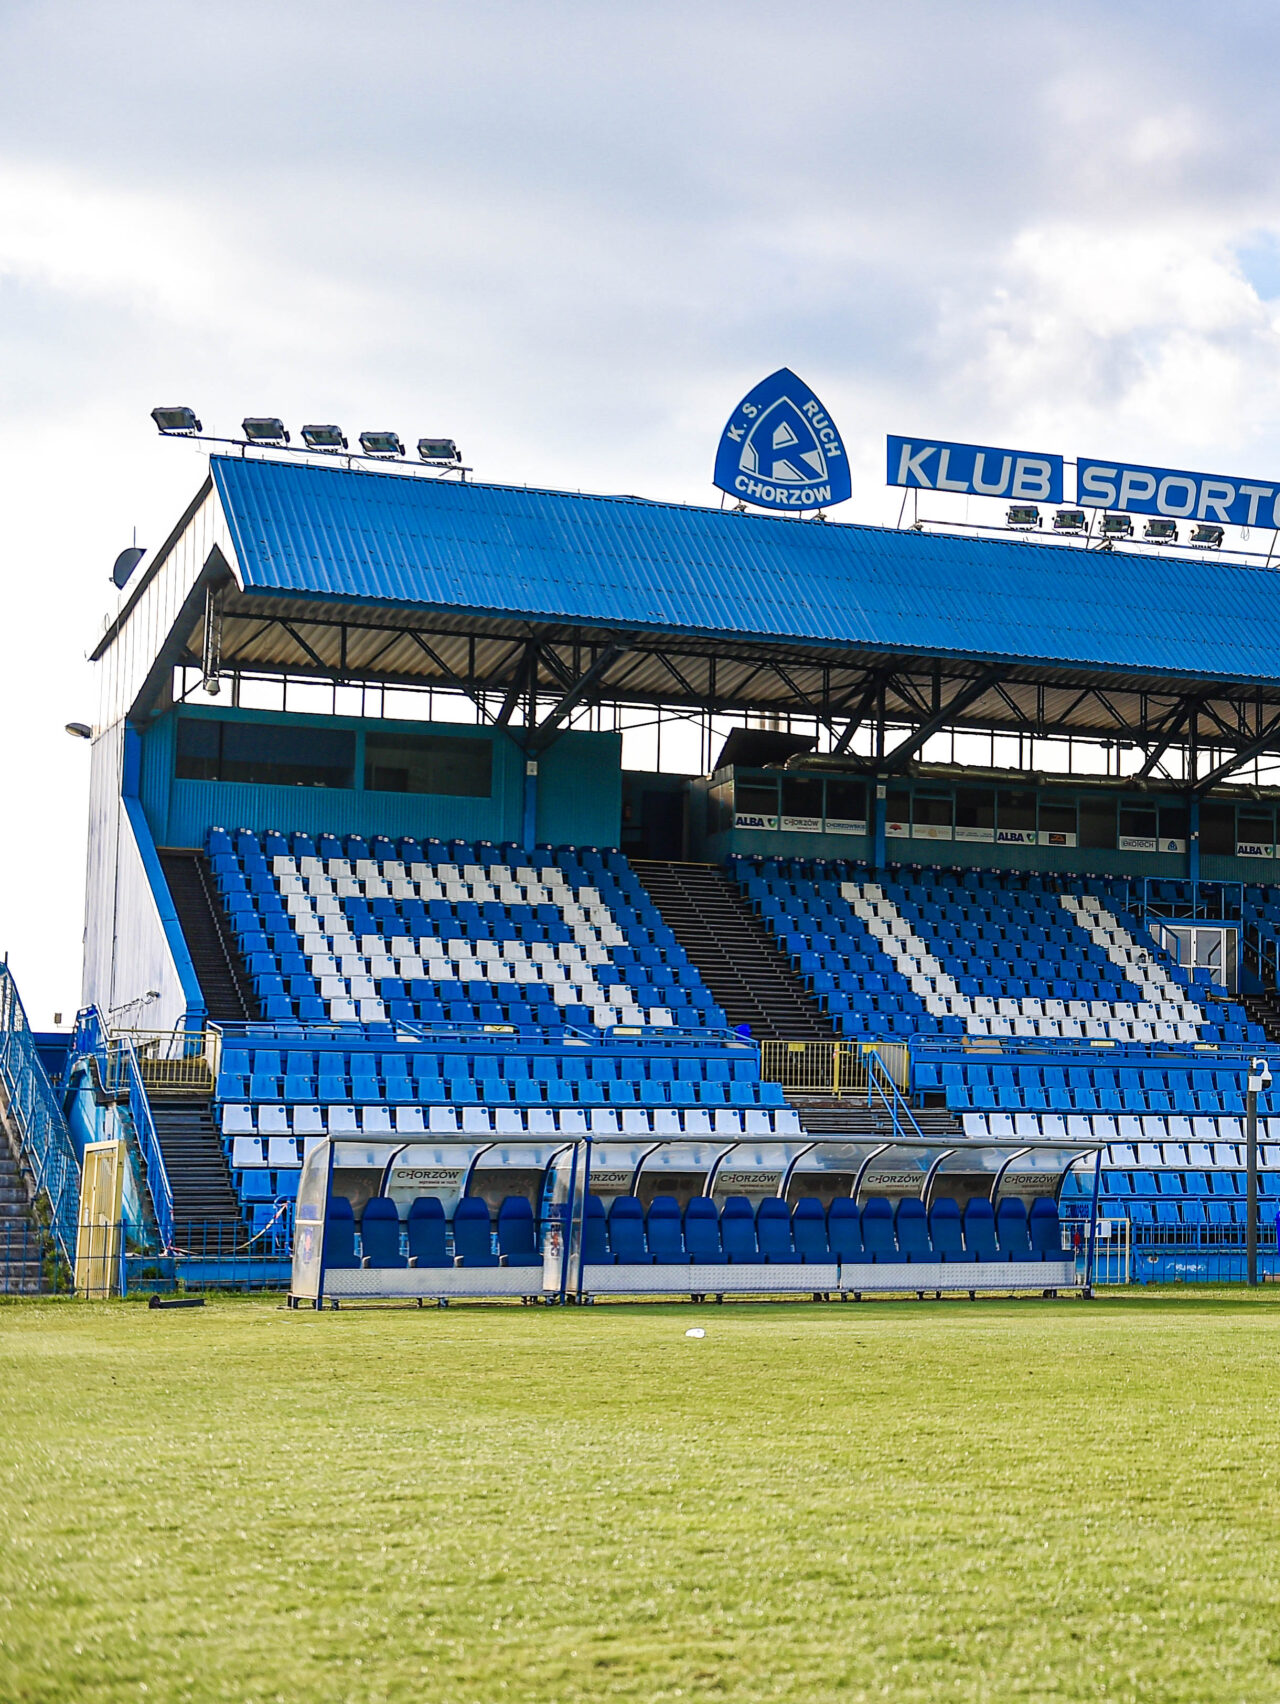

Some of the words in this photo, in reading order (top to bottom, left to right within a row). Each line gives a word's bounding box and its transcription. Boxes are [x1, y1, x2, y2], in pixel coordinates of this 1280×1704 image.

[802, 399, 841, 457] RUCH
[897, 443, 1052, 499] KLUB
[734, 475, 831, 505] CHORZÓW
[736, 816, 765, 827] ALBA
[784, 818, 818, 827] CHORZÓW
[998, 832, 1024, 842] ALBA
[1237, 845, 1262, 855] ALBA
[397, 1170, 459, 1180] CHORZÓW
[590, 1172, 628, 1181] RZÓW
[720, 1173, 778, 1183] CHORZÓW
[867, 1174, 922, 1183] CHORZÓW
[1004, 1174, 1056, 1184] CHORZÓW
